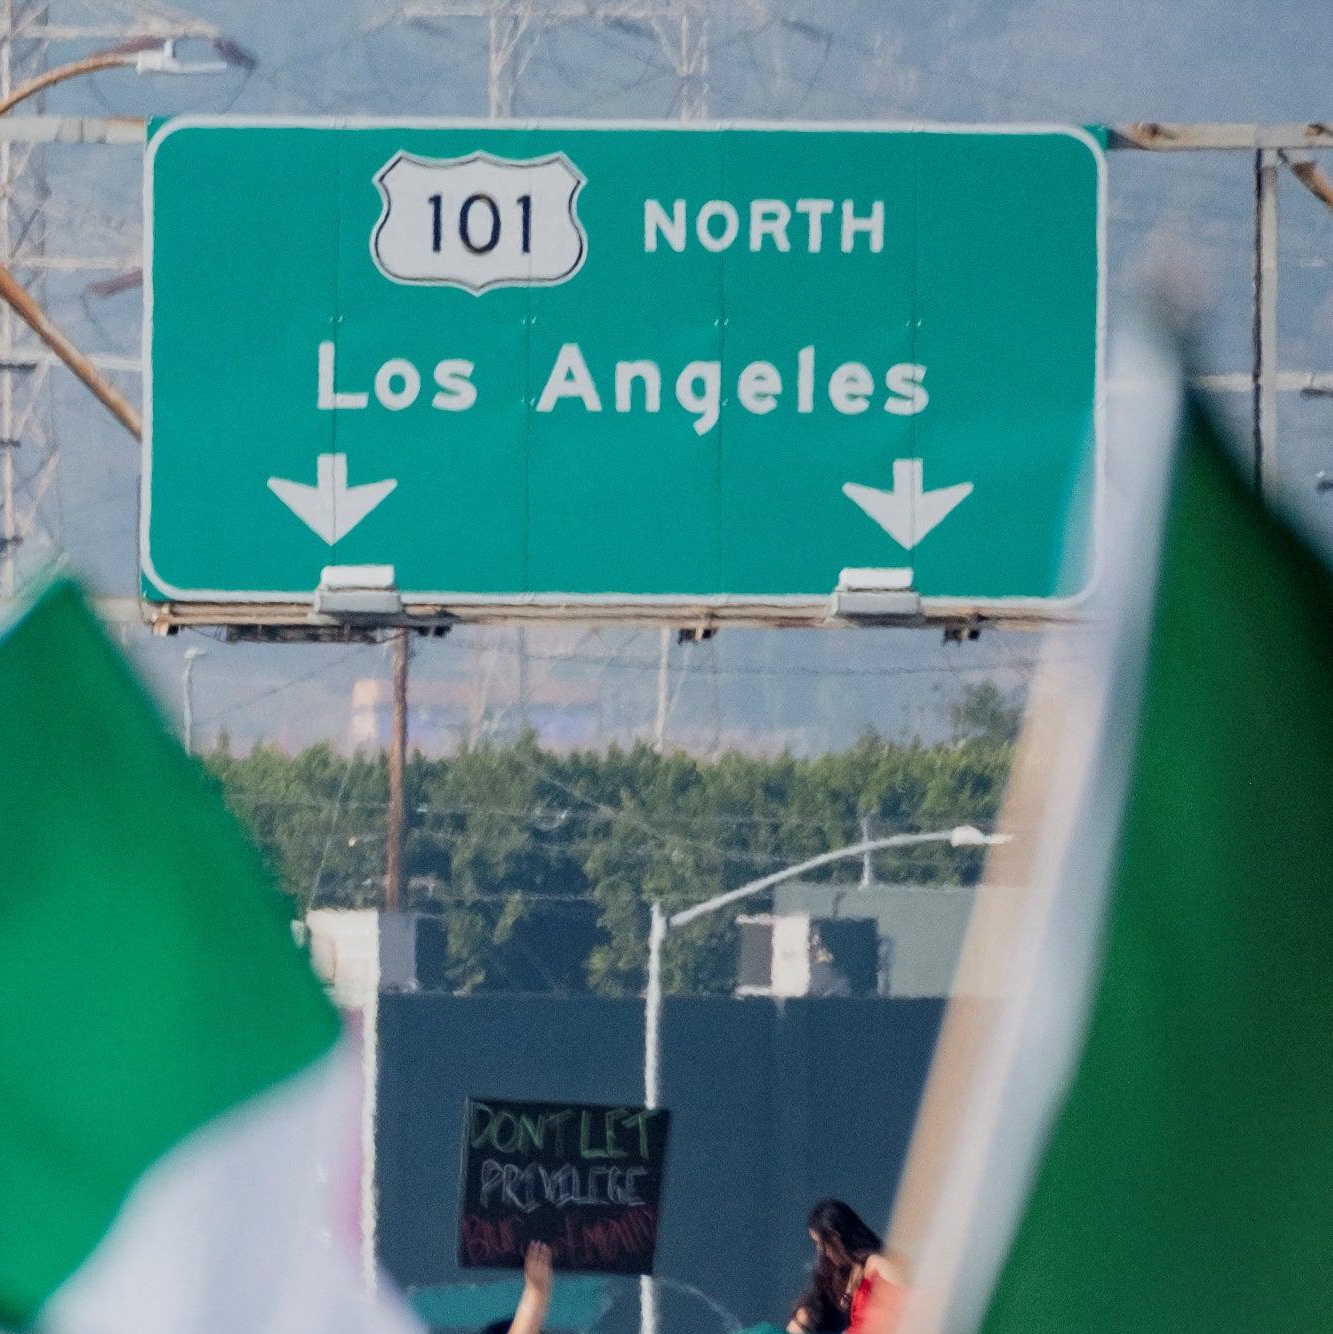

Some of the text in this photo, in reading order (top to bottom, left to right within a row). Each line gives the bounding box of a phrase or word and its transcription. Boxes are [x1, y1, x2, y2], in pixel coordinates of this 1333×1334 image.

[427, 192, 532, 257] 101
[644, 199, 885, 254] NORTH
[317, 342, 930, 435] Los Angeles
[580, 1108, 659, 1160] LET
[480, 1159, 648, 1213] PRIVILEGE
